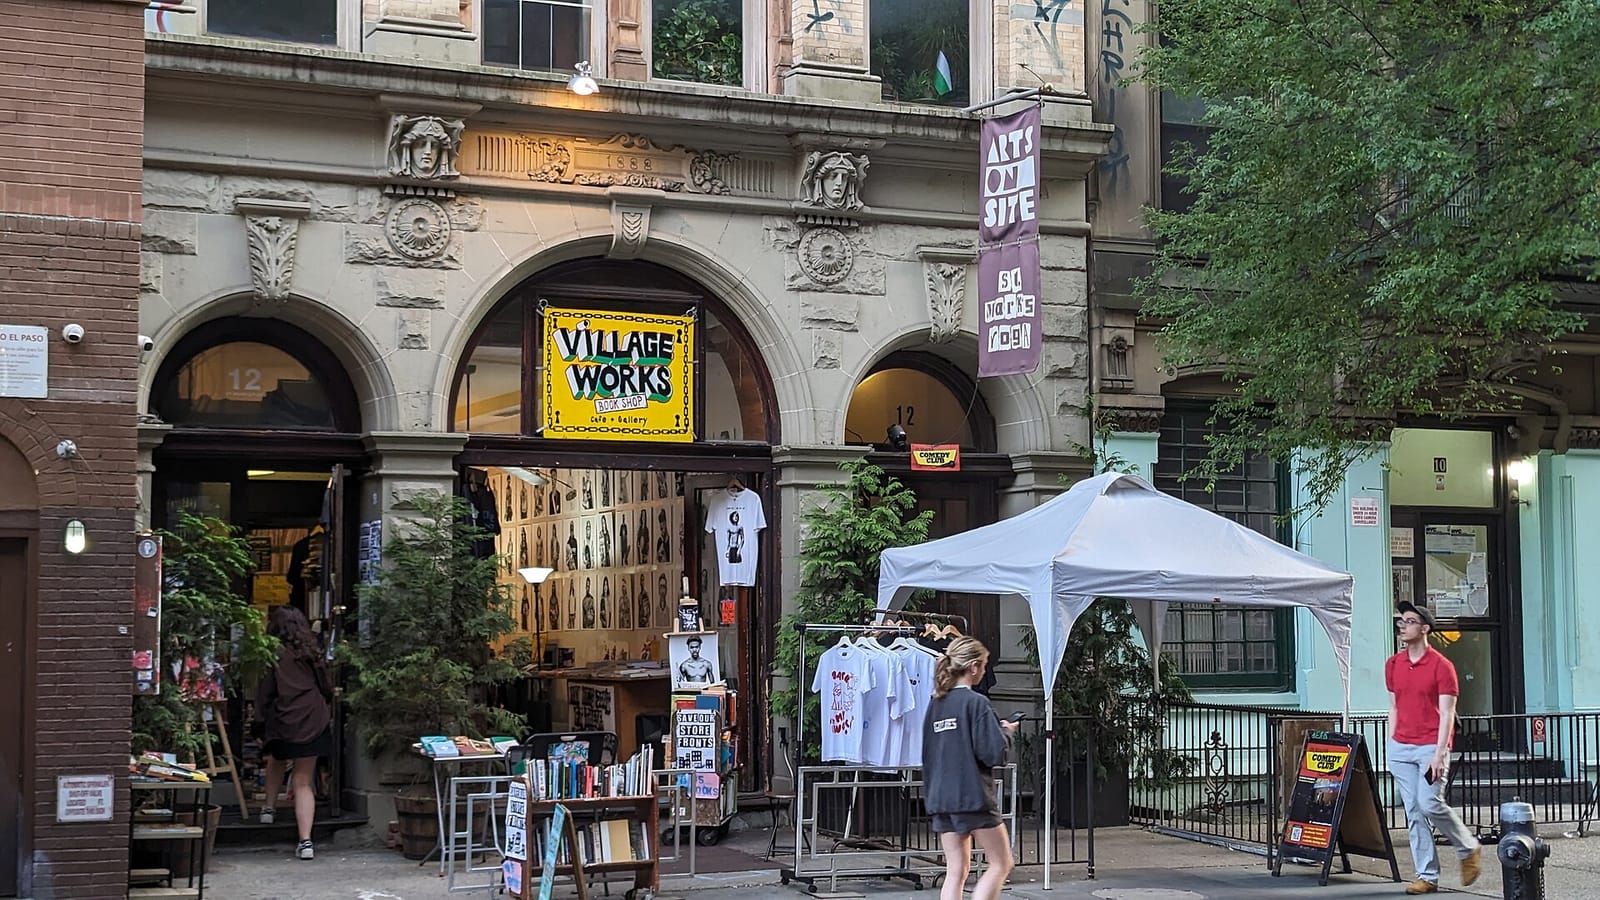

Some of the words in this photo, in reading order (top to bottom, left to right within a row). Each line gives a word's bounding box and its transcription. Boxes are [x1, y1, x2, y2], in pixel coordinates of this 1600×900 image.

[987, 126, 1034, 163] ARTS
[987, 166, 1019, 194] ON
[984, 188, 1035, 228] SITE
[9, 333, 19, 341] EL
[21, 334, 44, 342] PASO
[552, 319, 675, 366] VILLAGE
[229, 368, 261, 390] 12
[565, 364, 673, 403] WORKS
[598, 399, 620, 412] BOOK
[622, 396, 643, 408] SHOP
[618, 415, 648, 426] Gallery
[896, 405, 914, 426] 12
[1435, 458, 1446, 472] 10
[677, 714, 697, 723] SAVE
[680, 725, 710, 735] STORE
[678, 738, 713, 748] FRONTS
[1312, 754, 1342, 763] COMEDY
